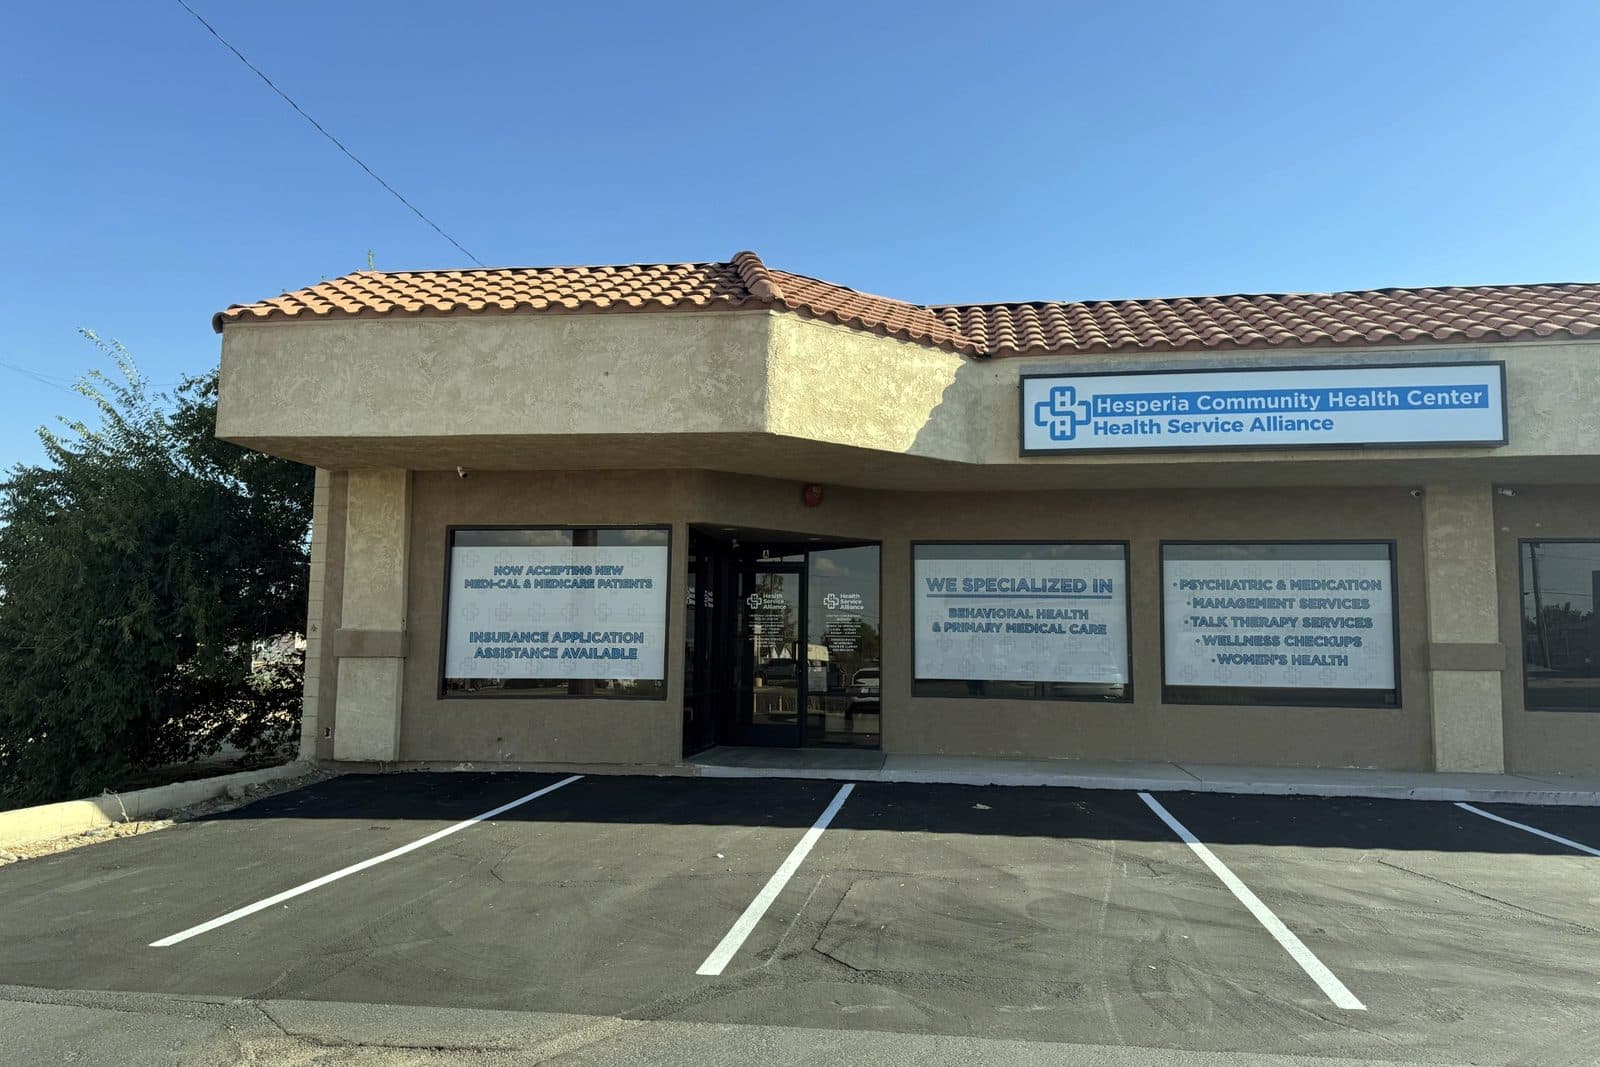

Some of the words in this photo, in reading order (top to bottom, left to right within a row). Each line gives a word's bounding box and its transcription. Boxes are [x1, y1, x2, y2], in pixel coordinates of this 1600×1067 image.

[1097, 397, 1189, 416] Hesperia
[1197, 393, 1321, 412] Community
[1328, 389, 1400, 407] Health
[1407, 388, 1483, 405] Center
[1094, 419, 1161, 435] Health
[1168, 417, 1244, 433] Service
[1250, 416, 1334, 432] Alliance
[494, 565, 524, 576] NOW
[526, 565, 592, 575] ACCEPTING
[595, 565, 624, 575] NEW
[464, 579, 521, 589] MEDI-CAL
[523, 579, 531, 589] &
[534, 579, 595, 589] MEDICARE
[598, 579, 653, 589] PATIENTS
[926, 577, 957, 592] WE
[962, 578, 1087, 593] SPECIALIZED
[1093, 579, 1113, 593] IN
[1179, 579, 1273, 591] PSYCHIATRIC
[1276, 579, 1287, 590] &
[1290, 579, 1382, 591] MEDICATION
[1193, 598, 1296, 609] MANAGEMENT
[1299, 598, 1370, 609] SERVICES
[949, 608, 1033, 619] BEHAVIORAL
[1036, 609, 1088, 620] HEALTH
[1190, 616, 1228, 627] TALK
[1231, 616, 1298, 628] THERAPY
[1302, 617, 1373, 628] SERVICES
[932, 622, 941, 632] &
[944, 622, 1003, 633] PRIMARY
[1006, 623, 1066, 634] MEDICAL
[1069, 624, 1107, 635] CARE
[470, 632, 549, 643] INSURANCE
[551, 632, 644, 644] APPLICATION
[1202, 635, 1280, 647] WELLNESS
[1284, 635, 1362, 647] CHECKUPS
[474, 647, 558, 659] ASSISTANCE
[561, 647, 638, 659] AVAILABLE
[1217, 654, 1288, 665] WOMEN'S
[1291, 655, 1348, 666] HEALTH
